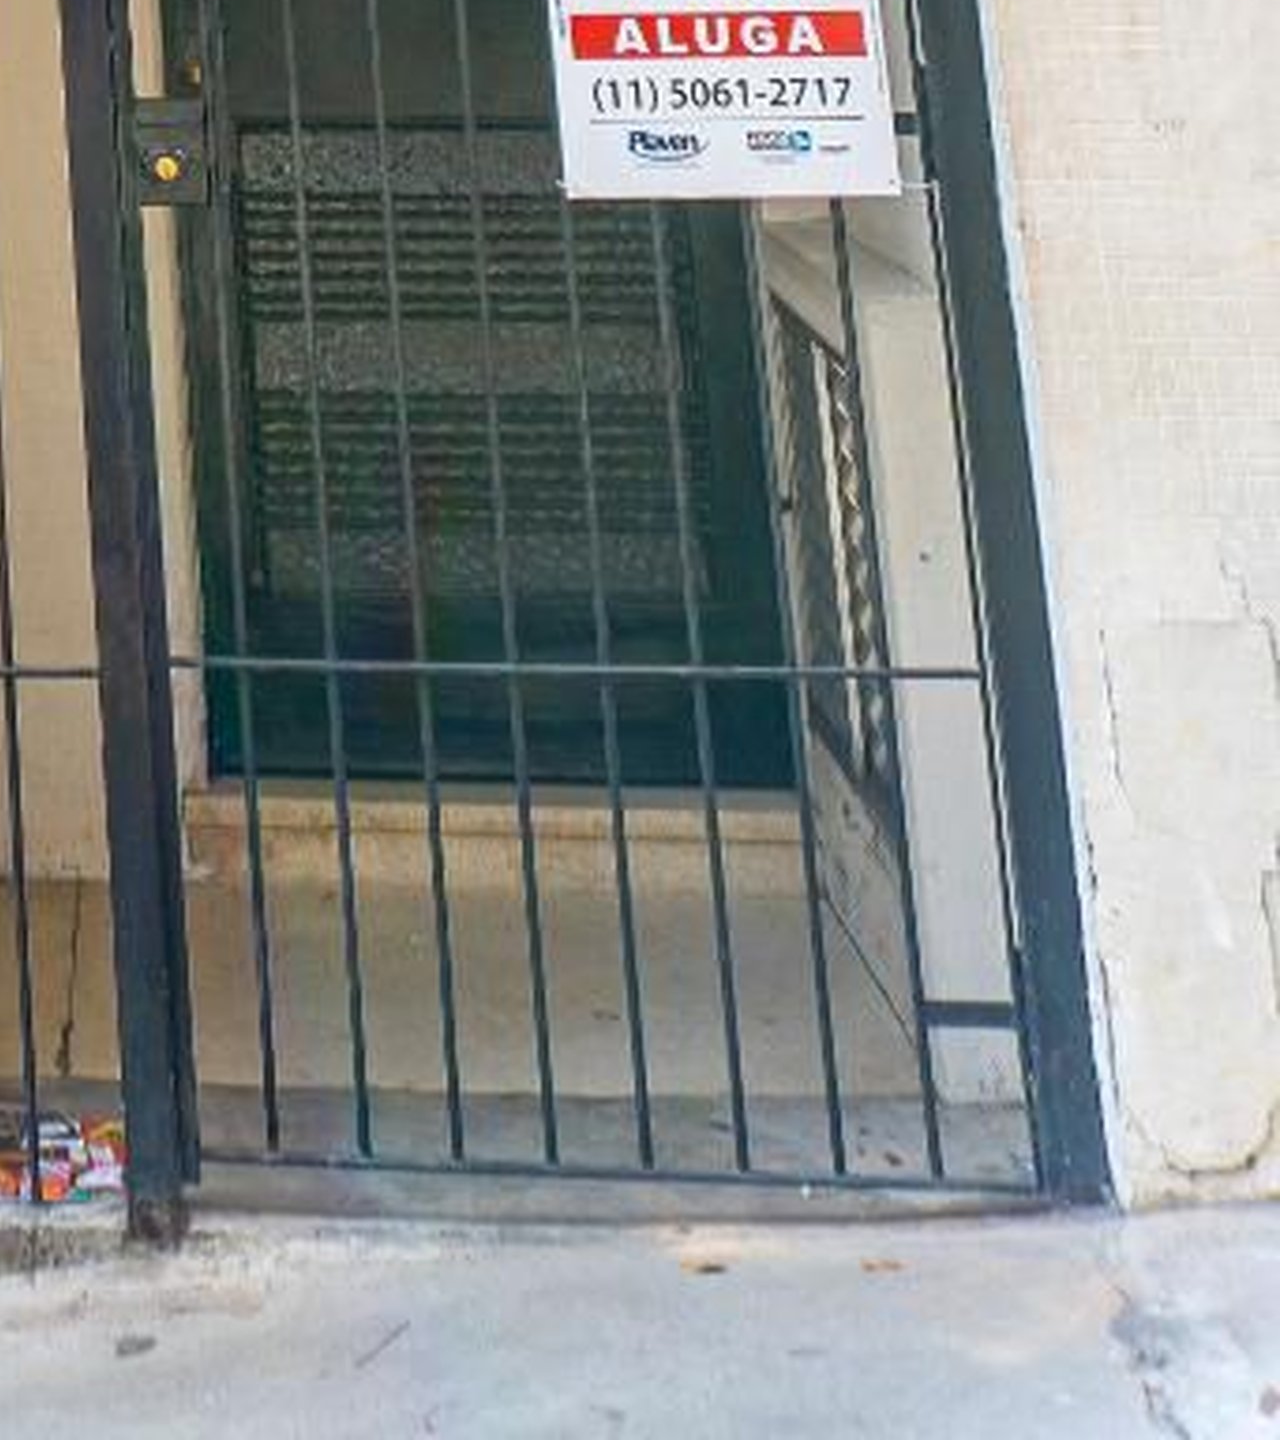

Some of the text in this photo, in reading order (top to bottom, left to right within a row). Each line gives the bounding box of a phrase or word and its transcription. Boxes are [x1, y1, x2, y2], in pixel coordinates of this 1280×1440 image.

[613, 18, 825, 55] ALUGA
[591, 78, 852, 113] (11) 5061-2717
